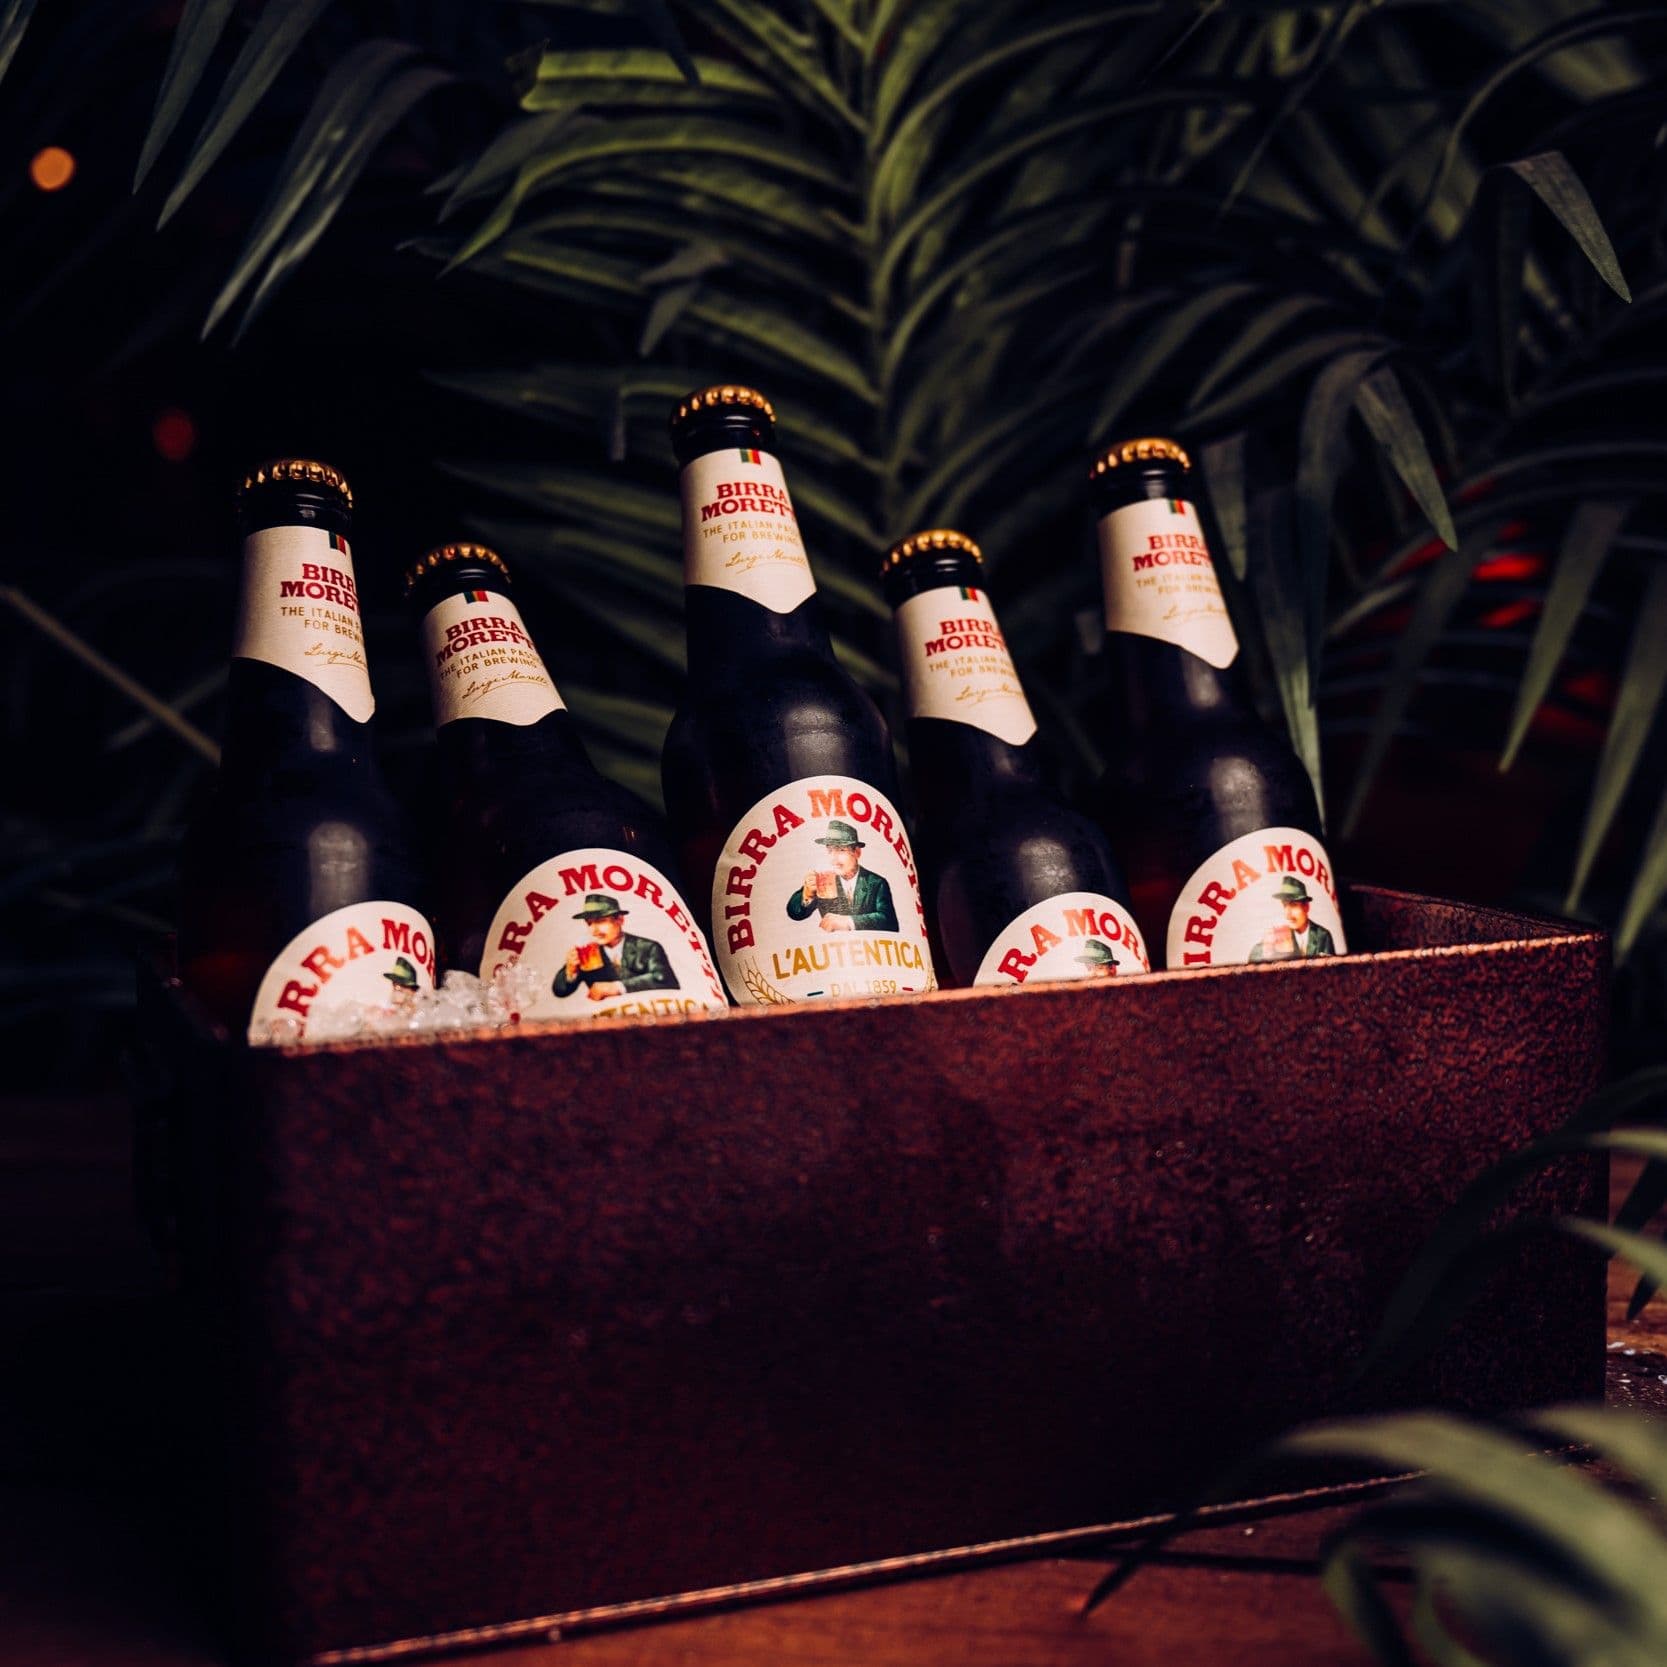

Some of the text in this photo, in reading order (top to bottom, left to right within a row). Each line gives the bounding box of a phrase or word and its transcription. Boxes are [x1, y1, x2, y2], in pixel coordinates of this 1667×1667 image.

[716, 482, 787, 503] BIRRA
[703, 525, 722, 538] THE
[728, 521, 773, 530] ITALIAN
[722, 533, 746, 544] FOR
[280, 606, 305, 617] THE
[311, 607, 354, 627] ITALIAN
[304, 619, 330, 632] FOR
[445, 616, 523, 642] BIRRA
[440, 663, 457, 680] THE
[460, 648, 506, 666] ITALIAN
[456, 663, 479, 678] FOR
[929, 659, 949, 672] THE
[725, 804, 806, 954] BIRRA
[1183, 859, 1262, 966] IRRA
[772, 939, 925, 980] L'AUTENTICA
[997, 924, 1062, 984] RA
[866, 979, 897, 995] 1859
